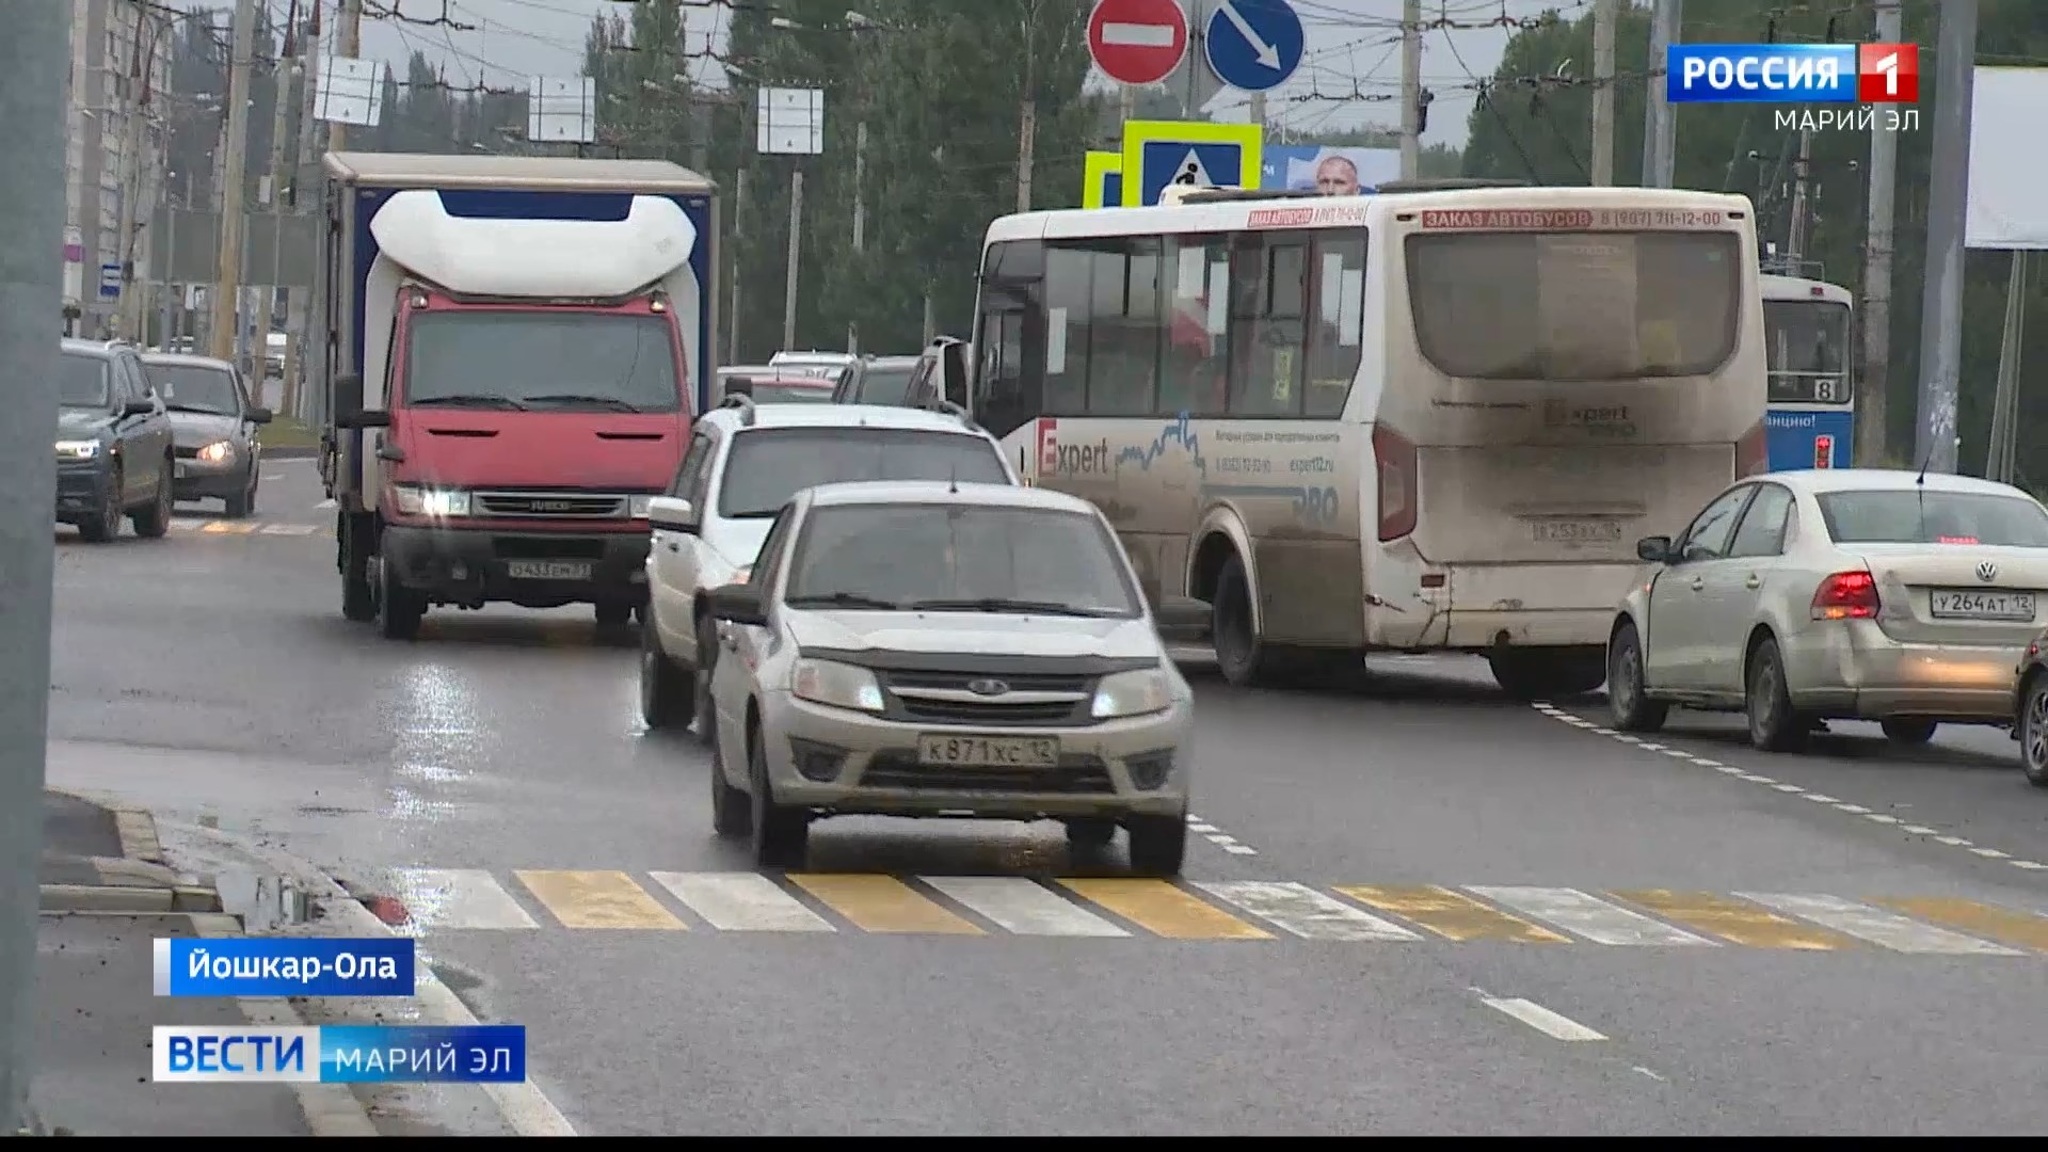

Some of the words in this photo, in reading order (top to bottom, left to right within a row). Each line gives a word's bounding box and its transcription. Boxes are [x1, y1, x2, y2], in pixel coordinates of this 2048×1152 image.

[1426, 211, 1483, 227] ЗАКАЗ
[1488, 211, 1589, 227] АВТОБУСОВ
[1601, 213, 1610, 225] 8
[1818, 381, 1831, 400] 8
[1038, 418, 1108, 480] Expert
[1940, 594, 2007, 612] У264АТ
[2012, 595, 2030, 609] 12
[929, 739, 1021, 763] К871ХС
